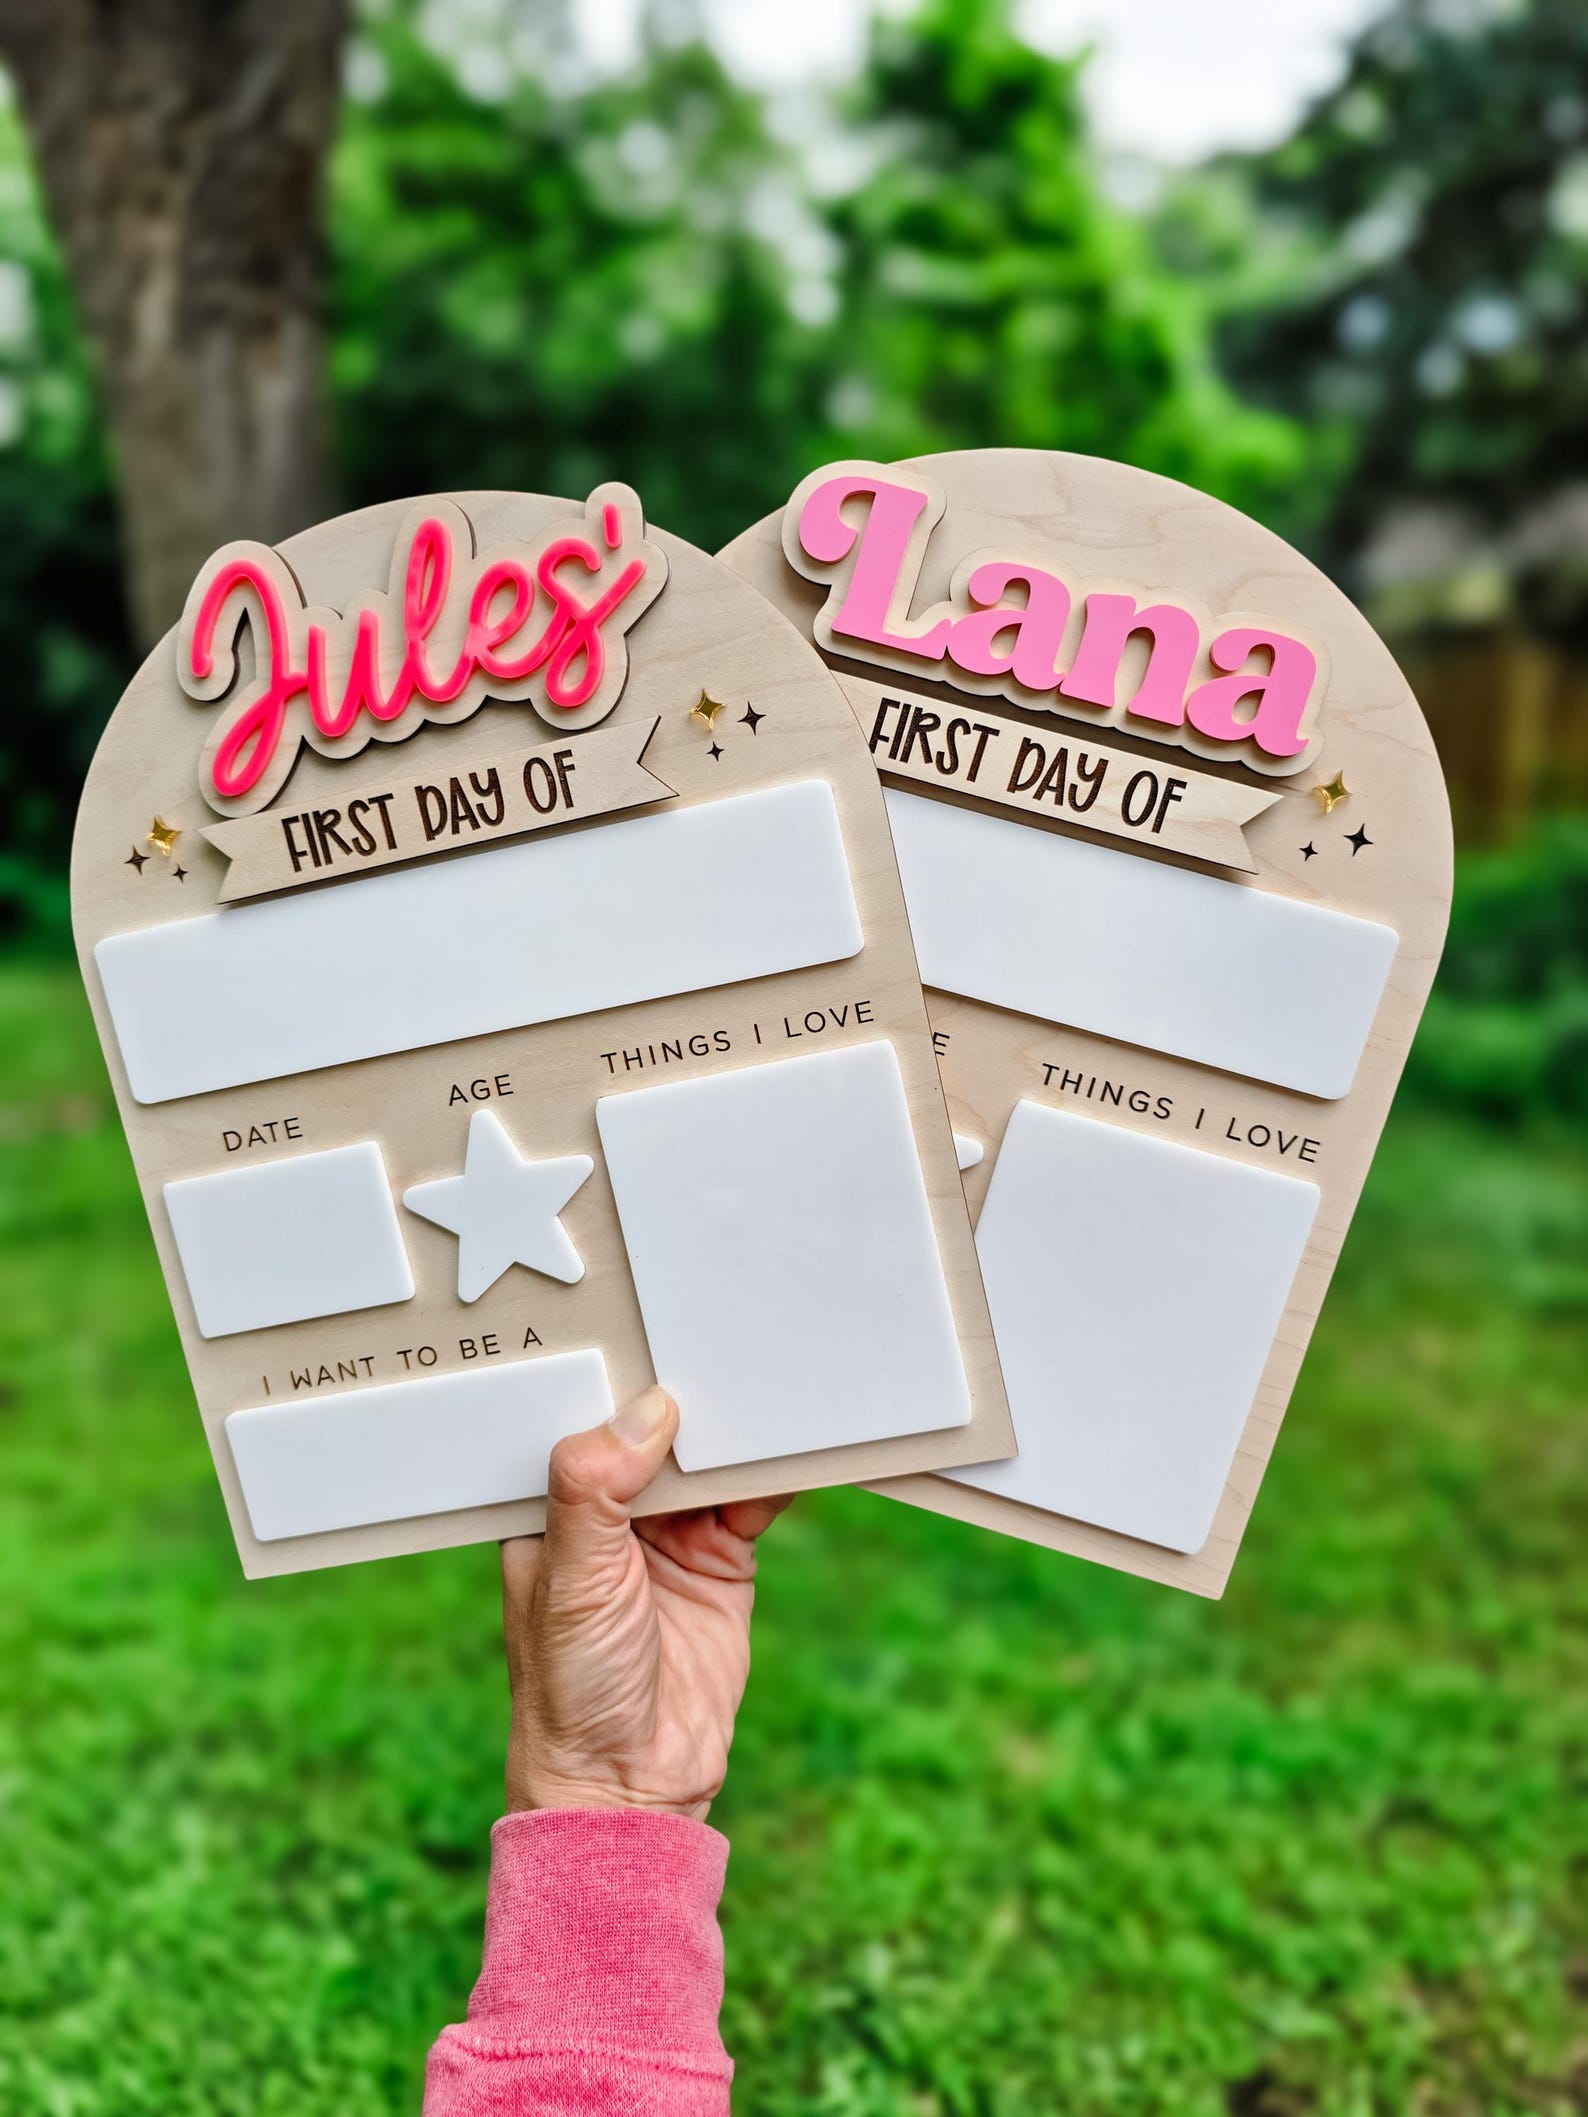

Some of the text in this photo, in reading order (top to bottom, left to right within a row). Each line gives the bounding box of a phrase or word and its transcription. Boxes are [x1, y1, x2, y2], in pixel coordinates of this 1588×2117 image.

[799, 476, 1317, 757] Lana
[869, 697, 1187, 834] FIRST DAY OF
[281, 749, 576, 873] FIRST DAY OF
[600, 1000, 875, 1074] THINGS I LOVE
[448, 1073, 514, 1107] AGE
[1041, 1062, 1321, 1163] THINGS I LOVE
[222, 1117, 304, 1152] DATE
[263, 1326, 543, 1394] I WANT TO BE A
